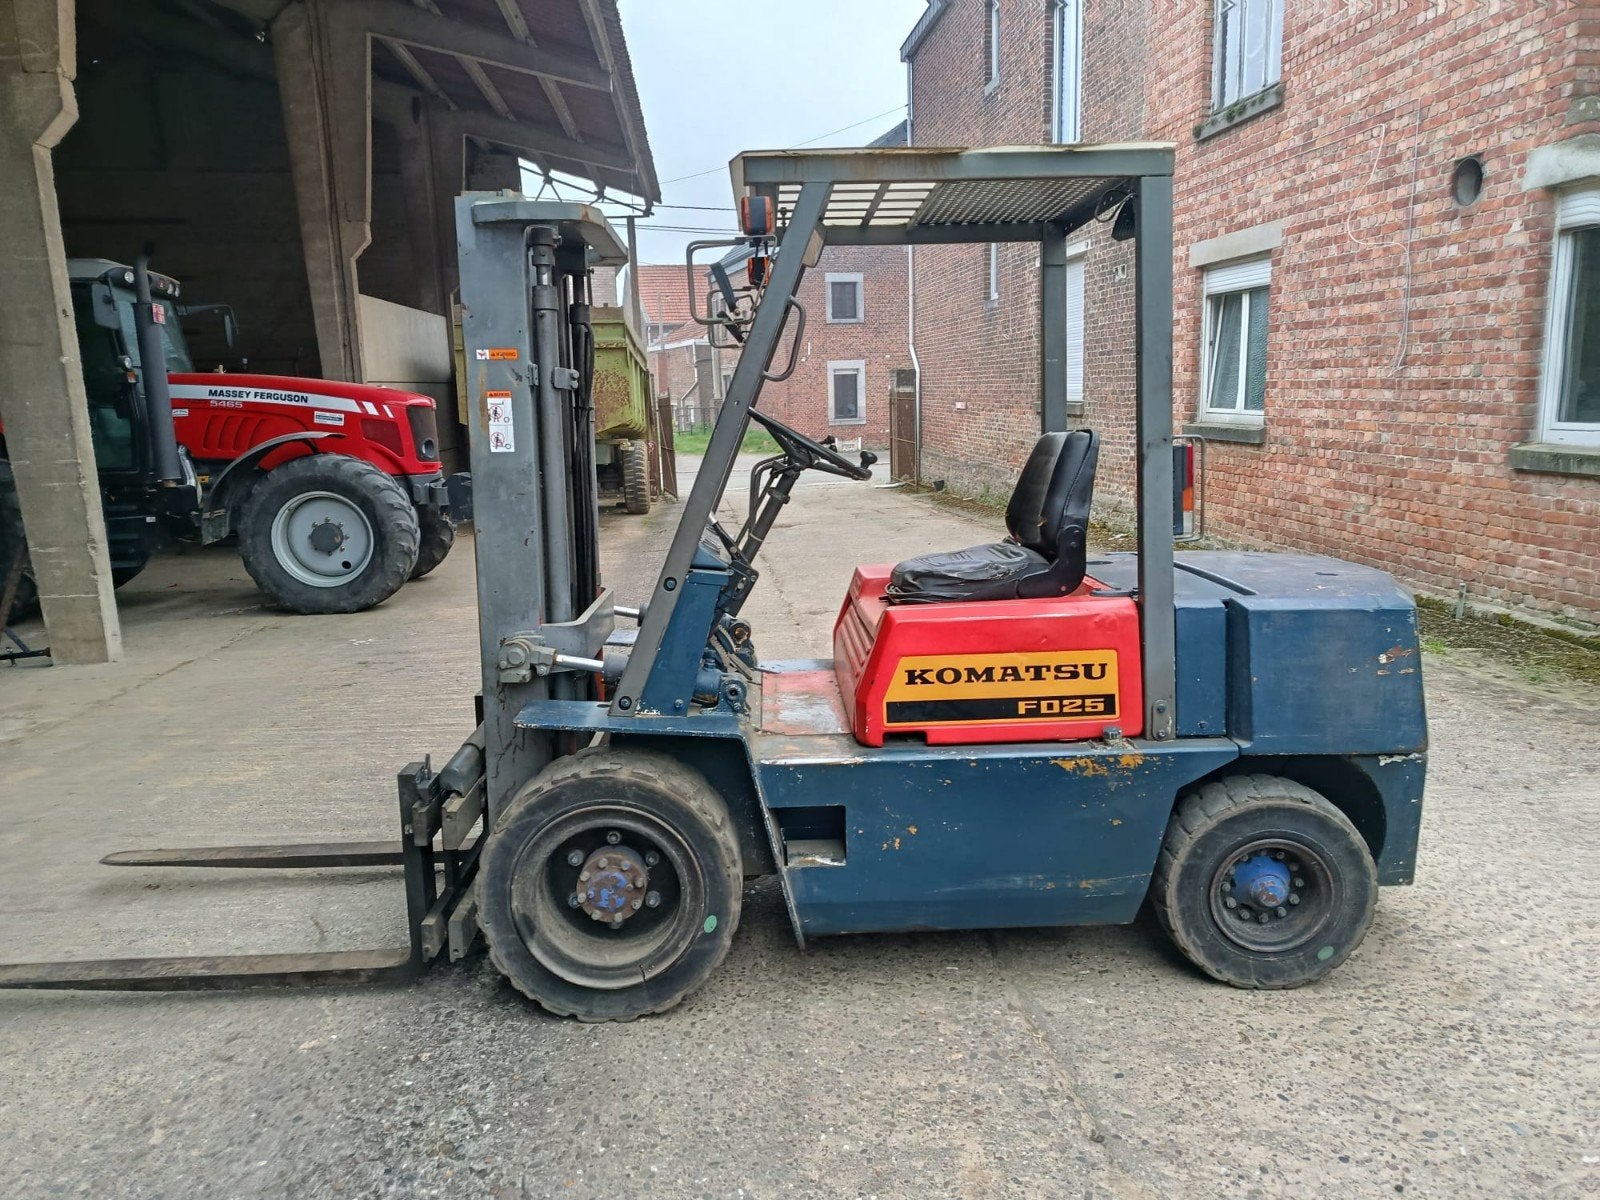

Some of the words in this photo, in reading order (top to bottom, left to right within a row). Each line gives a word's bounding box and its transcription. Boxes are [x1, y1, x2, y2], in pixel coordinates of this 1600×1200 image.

[208, 389, 251, 399] MASSEY
[253, 391, 308, 403] FERGUSON
[209, 400, 243, 408] 5465
[905, 663, 1107, 685] KOMATSU
[1018, 698, 1104, 715] FD25
